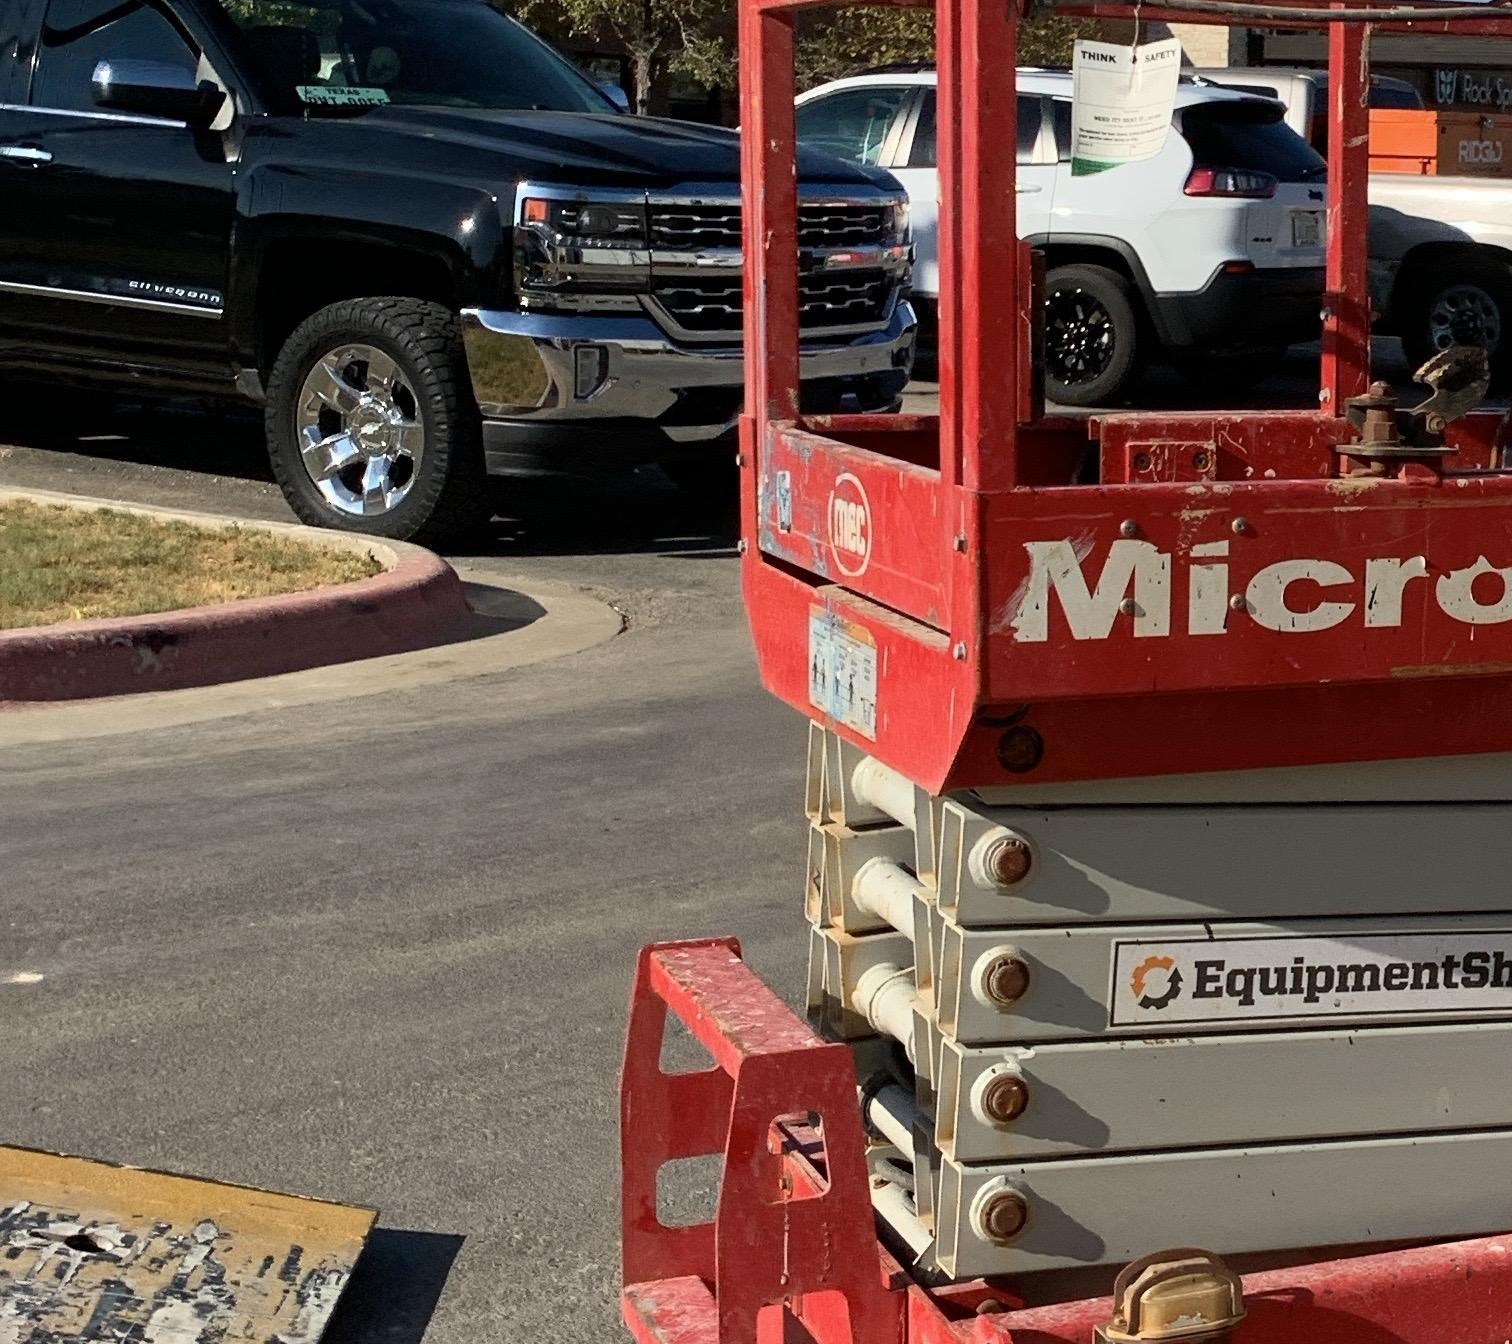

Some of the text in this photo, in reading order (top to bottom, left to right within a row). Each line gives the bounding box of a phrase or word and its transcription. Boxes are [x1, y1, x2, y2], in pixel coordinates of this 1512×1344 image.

[1080, 49, 1176, 64] THINK SAFETY
[1463, 75, 1492, 103] Rock
